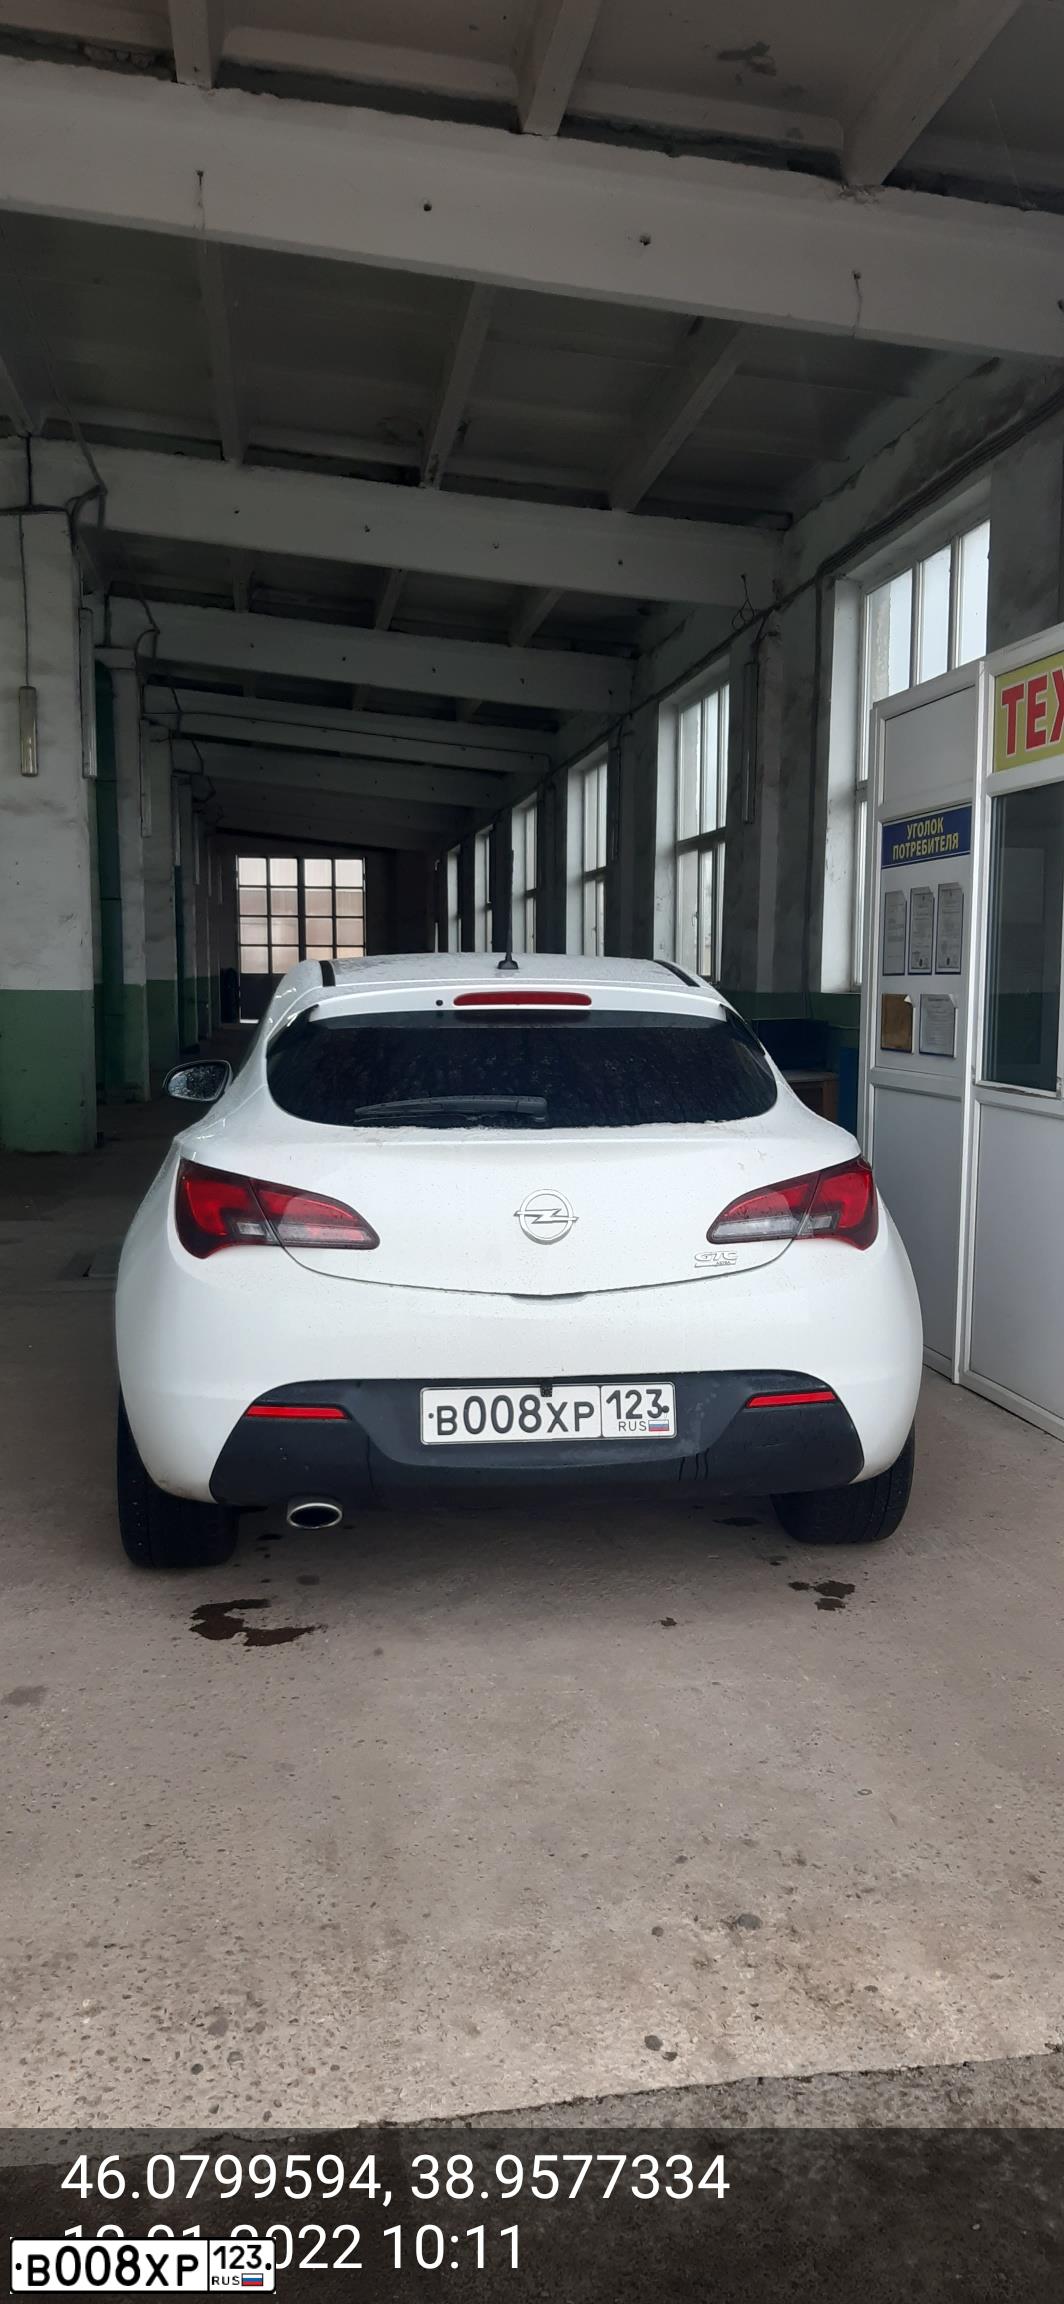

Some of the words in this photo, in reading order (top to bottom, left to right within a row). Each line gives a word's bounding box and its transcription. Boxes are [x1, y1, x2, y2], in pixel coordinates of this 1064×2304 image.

[907, 817, 944, 840] УГОЛОК
[893, 832, 959, 860] ПОТРЕБИТЕЛЯ
[695, 1250, 738, 1262] GTC
[606, 1389, 663, 1420] 123
[618, 1420, 647, 1432] RUS
